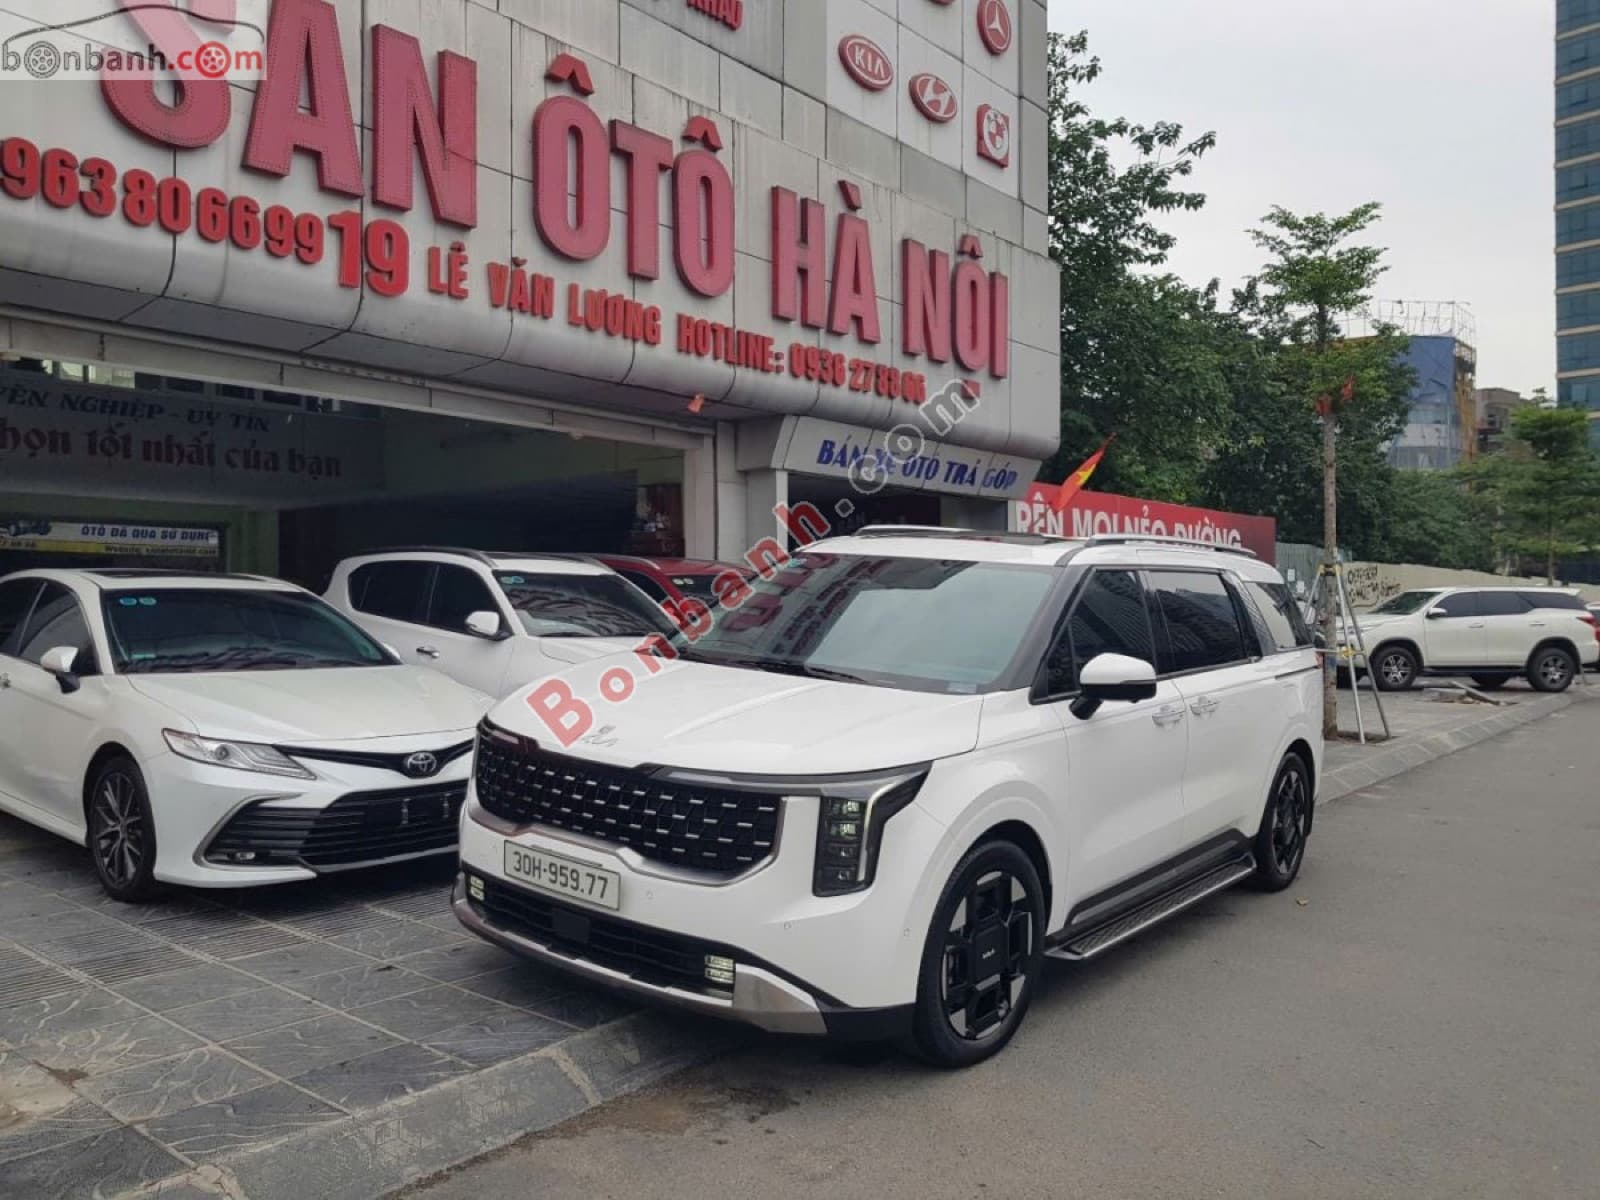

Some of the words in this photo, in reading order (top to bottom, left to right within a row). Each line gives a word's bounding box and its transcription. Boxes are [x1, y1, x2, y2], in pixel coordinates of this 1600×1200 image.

[855, 45, 885, 79] KIA
[531, 53, 735, 298] ÔTÔ
[771, 180, 881, 344] HÀ
[901, 233, 1008, 400] NỘI
[428, 241, 469, 299] LÊ
[487, 256, 555, 319] VĂN
[568, 282, 661, 345] LƯƠNG
[677, 314, 785, 373] HOTLINE:
[817, 434, 867, 469] BÁN
[982, 461, 1018, 491] GÓP
[513, 850, 609, 899] 30H-959.77
